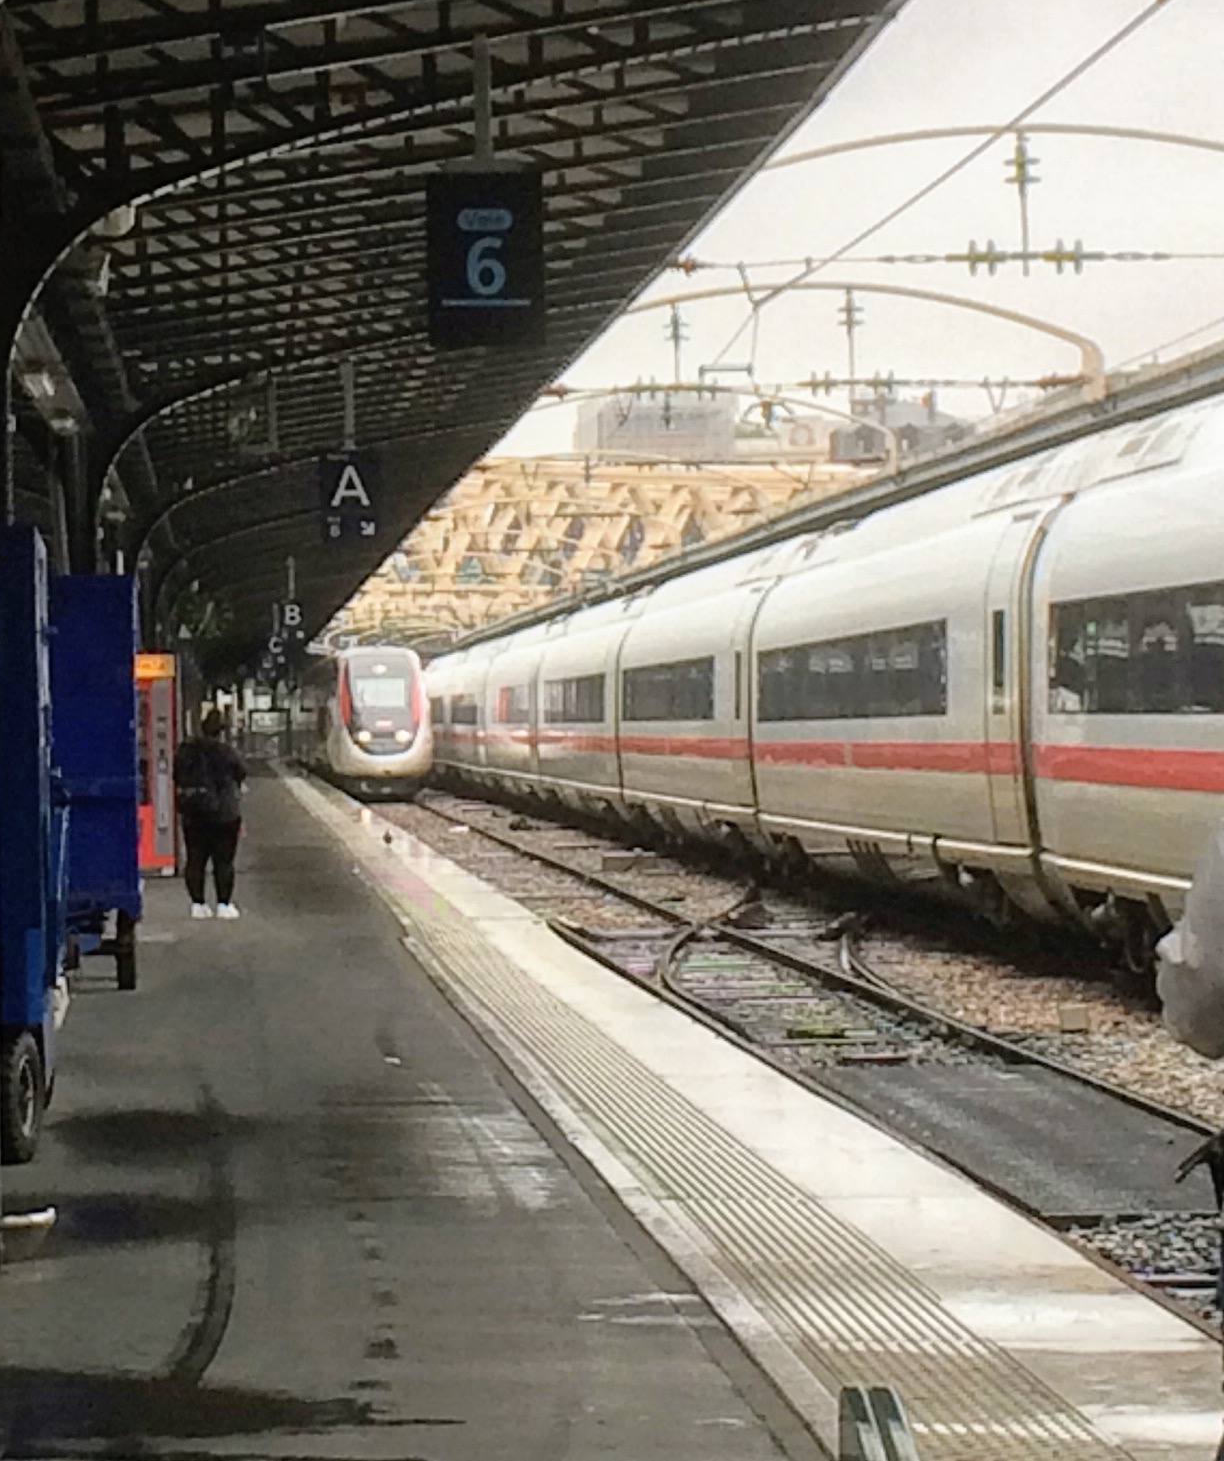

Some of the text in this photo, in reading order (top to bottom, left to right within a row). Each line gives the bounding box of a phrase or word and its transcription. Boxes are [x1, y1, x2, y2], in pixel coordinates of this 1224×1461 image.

[467, 236, 506, 296] 6
[330, 464, 371, 507] A
[284, 604, 302, 626] B
[268, 636, 283, 654] C
